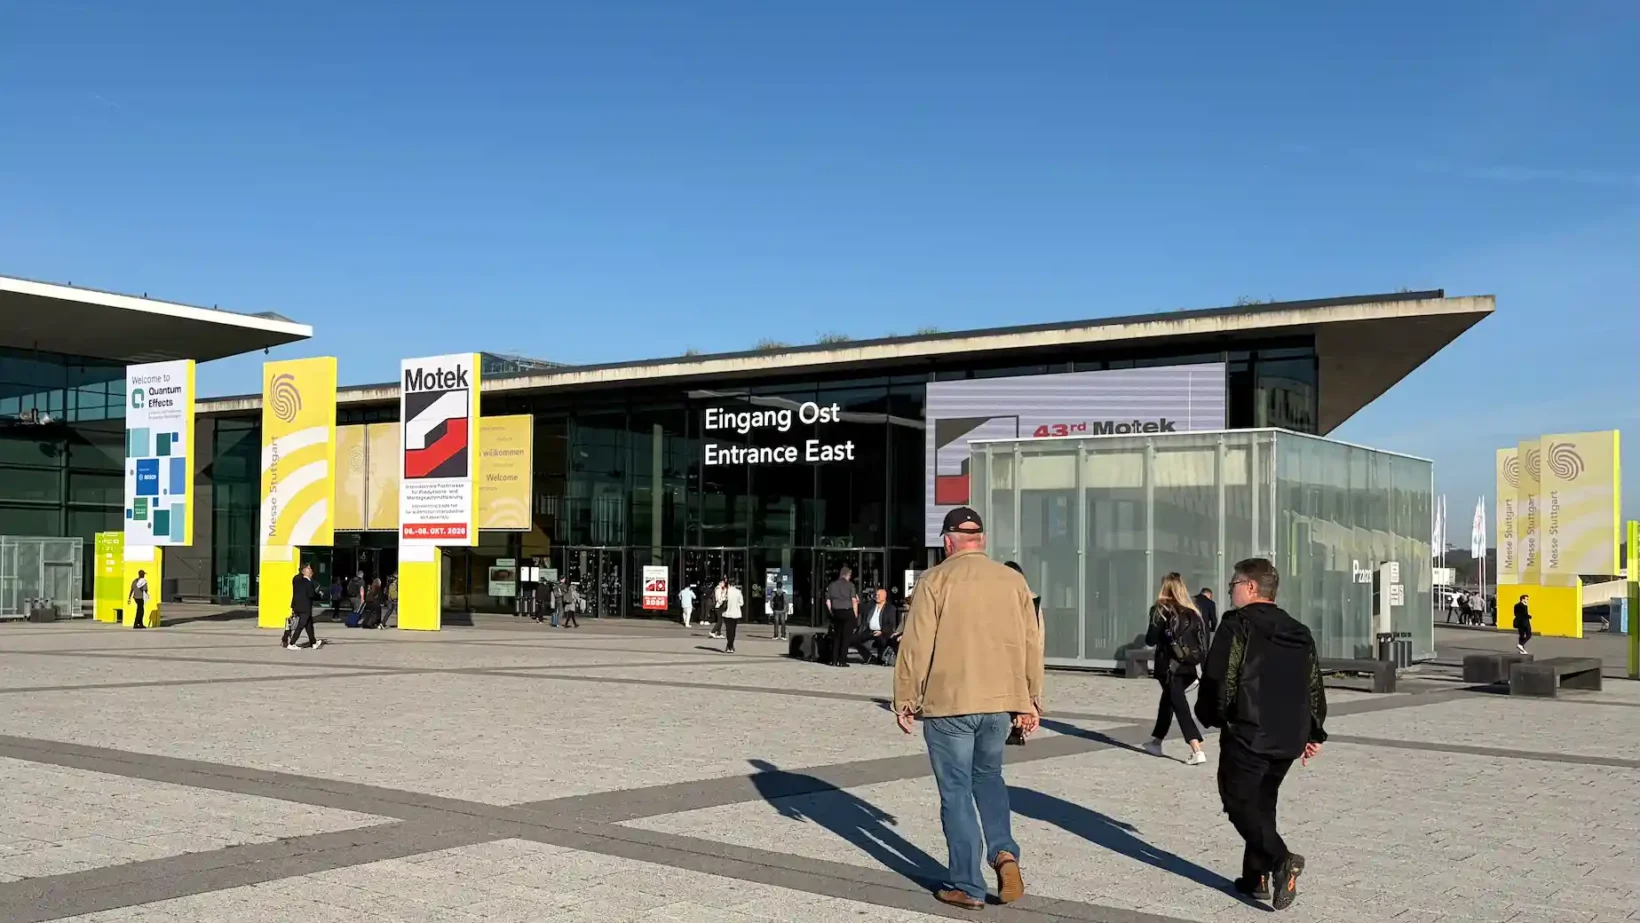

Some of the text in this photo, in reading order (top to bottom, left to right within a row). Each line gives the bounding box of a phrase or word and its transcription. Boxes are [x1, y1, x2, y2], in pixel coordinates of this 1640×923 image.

[132, 374, 171, 385] Welcome to
[405, 364, 469, 391] Motek
[148, 386, 182, 396] Quantum
[148, 398, 174, 408] Effects
[705, 401, 841, 434] Eingang Ost
[1033, 418, 1176, 438] 43rd Motek
[483, 448, 525, 457] willkommen
[705, 439, 855, 465] Entrance East
[269, 436, 280, 537] Messe Stuttgart
[486, 472, 519, 482] Welcome
[1505, 498, 1514, 569] Messe Stuttgart
[1526, 493, 1536, 567] Messe Stuttgart
[1549, 490, 1560, 569] Messe Stuttgart
